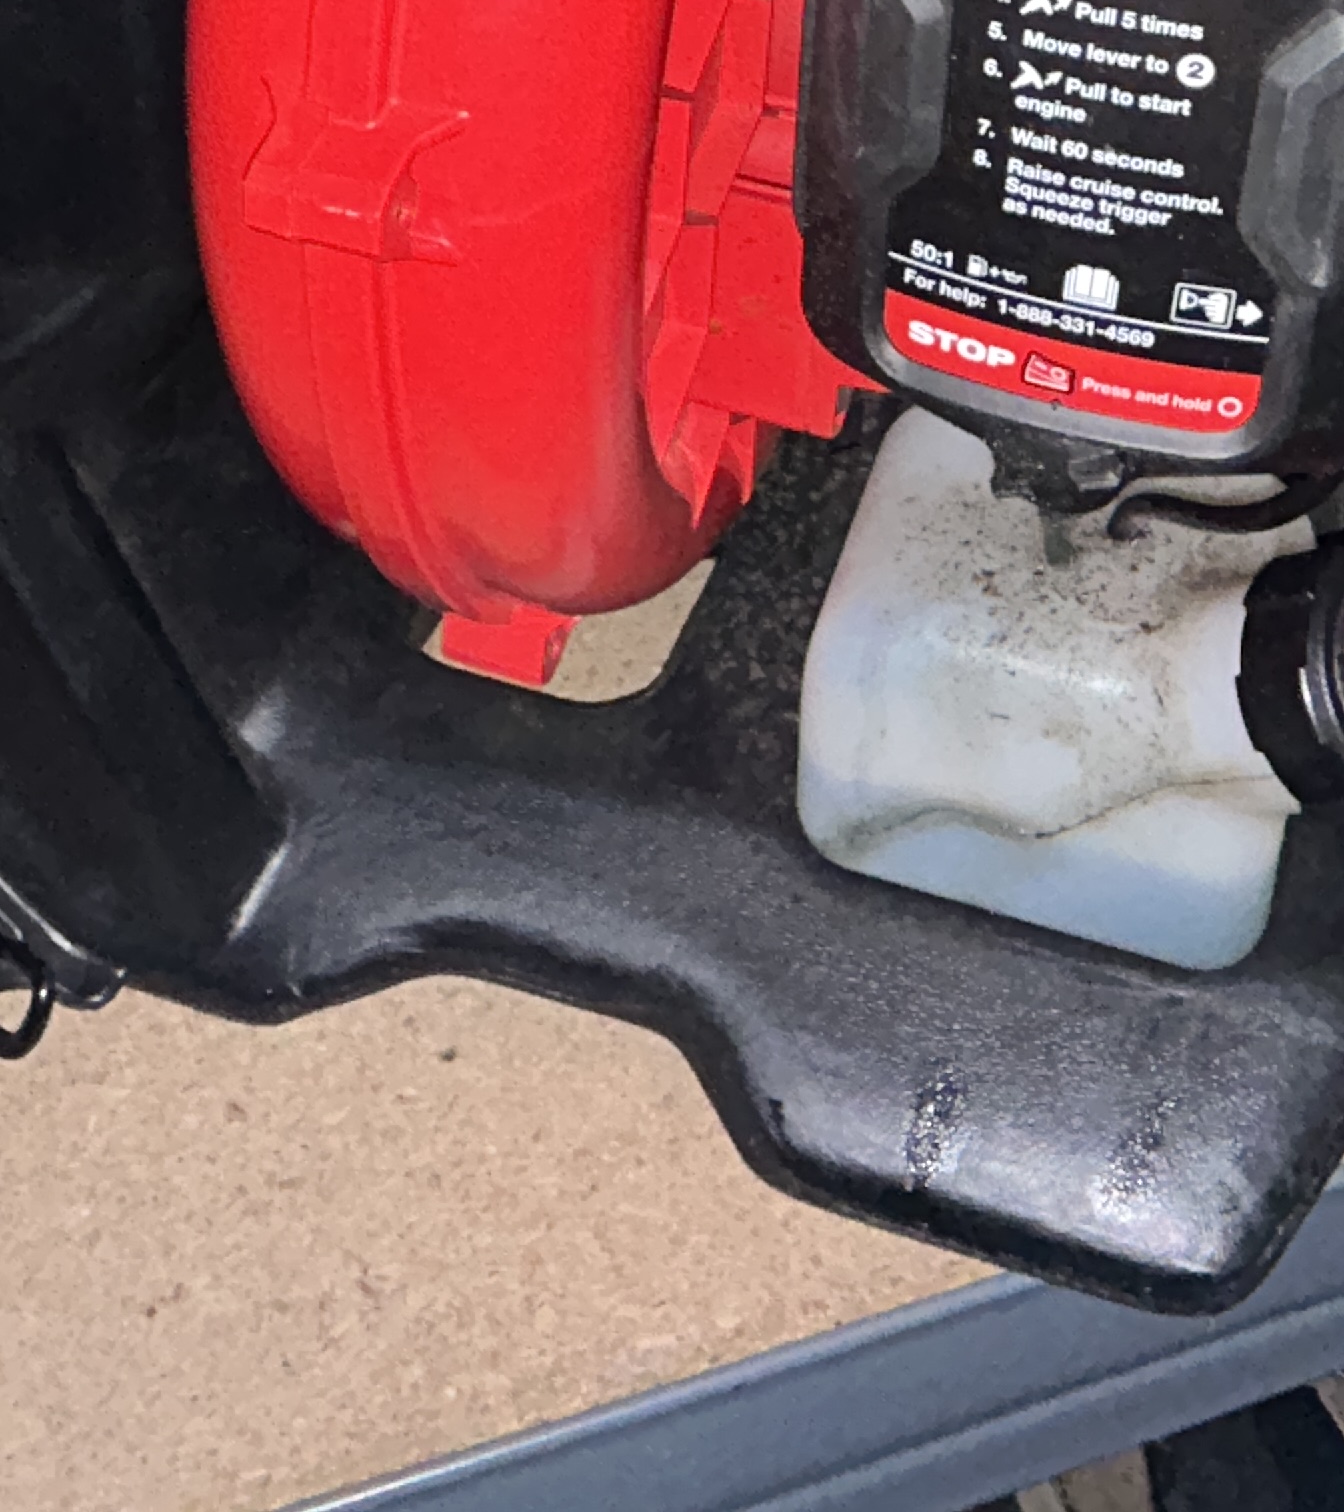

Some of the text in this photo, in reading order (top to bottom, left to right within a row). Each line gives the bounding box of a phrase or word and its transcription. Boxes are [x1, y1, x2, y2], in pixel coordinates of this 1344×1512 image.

[1074, 1, 1117, 27] Pull
[1121, 10, 1137, 30] 5
[1141, 13, 1204, 41] times
[987, 20, 1007, 41] 5.
[1022, 28, 1082, 58] Move
[1086, 42, 1141, 70] lever
[1145, 53, 1169, 74] to
[983, 57, 1192, 117] 6. Pull to start
[1014, 94, 1087, 124] engine
[976, 117, 1184, 179] 7. Wait 60 seconds
[973, 148, 1224, 216] 8. Raise cruise control.
[1004, 176, 1172, 227] Squeeze trigger
[1002, 198, 1116, 236] as needed.
[910, 238, 954, 269] 50:1
[903, 268, 1156, 348] For help: 1-888-331-4569
[907, 319, 1016, 367] STOP
[1081, 376, 1212, 413] Press and hold
